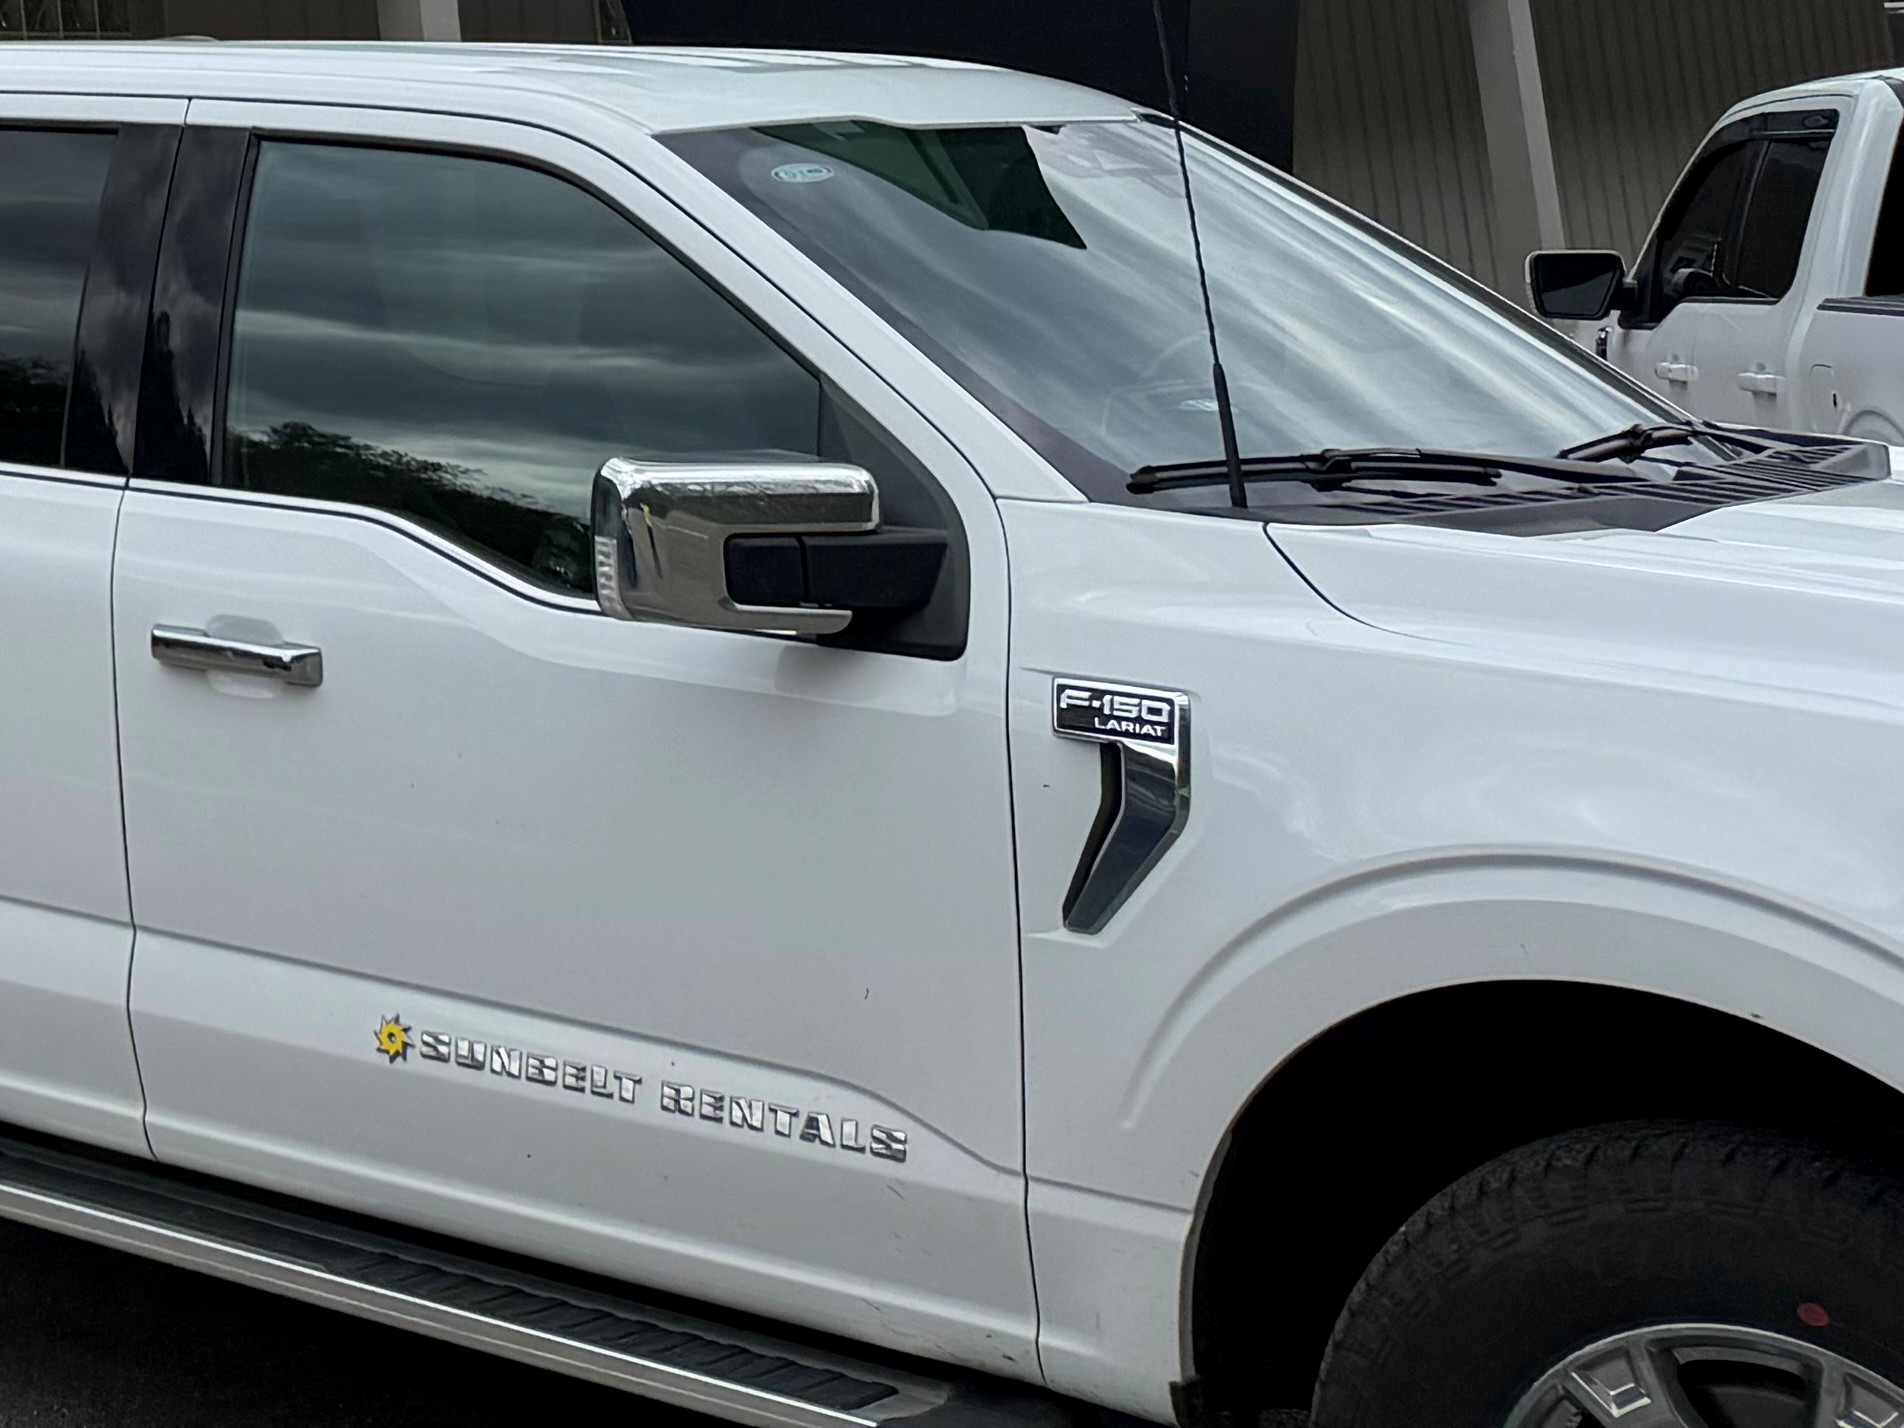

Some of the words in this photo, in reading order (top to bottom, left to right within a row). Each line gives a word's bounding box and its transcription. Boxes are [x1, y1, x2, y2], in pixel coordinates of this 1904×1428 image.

[1059, 688, 1171, 723] F-150
[1094, 716, 1166, 737] LARIAT
[420, 1030, 642, 1104] SUNBELT
[660, 1080, 908, 1163] RENTALS
